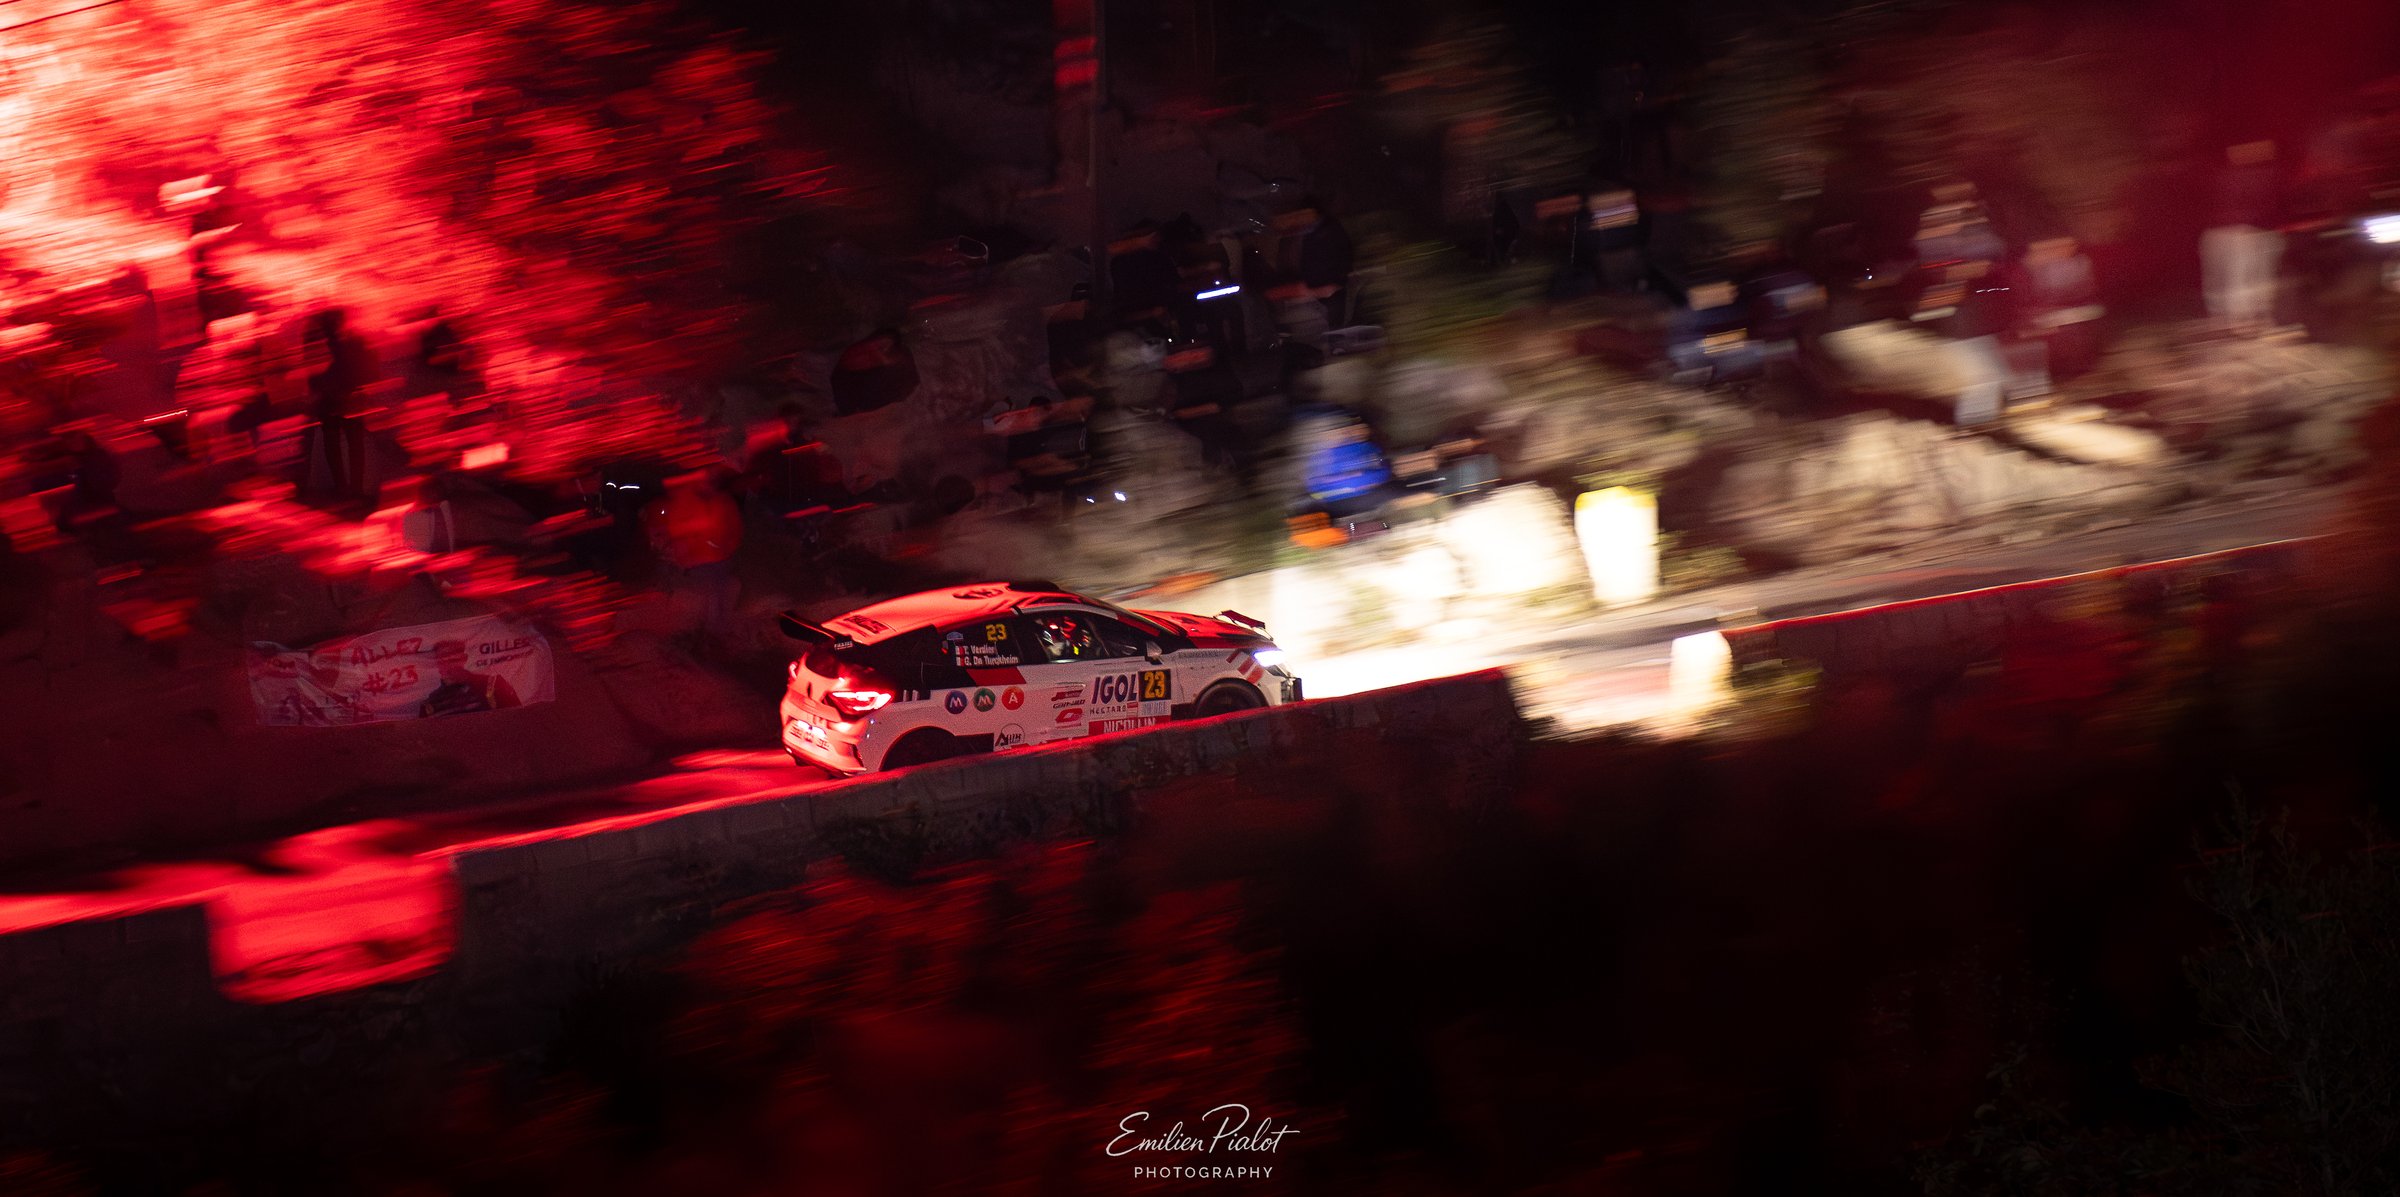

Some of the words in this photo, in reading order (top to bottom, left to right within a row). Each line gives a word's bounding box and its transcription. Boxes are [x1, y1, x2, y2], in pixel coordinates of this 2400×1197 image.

[985, 623, 1008, 642] 23
[351, 637, 422, 666] ALLEZ
[964, 655, 973, 666] G.
[361, 664, 419, 696] #23
[1091, 674, 1138, 704] IGOL
[1144, 671, 1165, 698] 23
